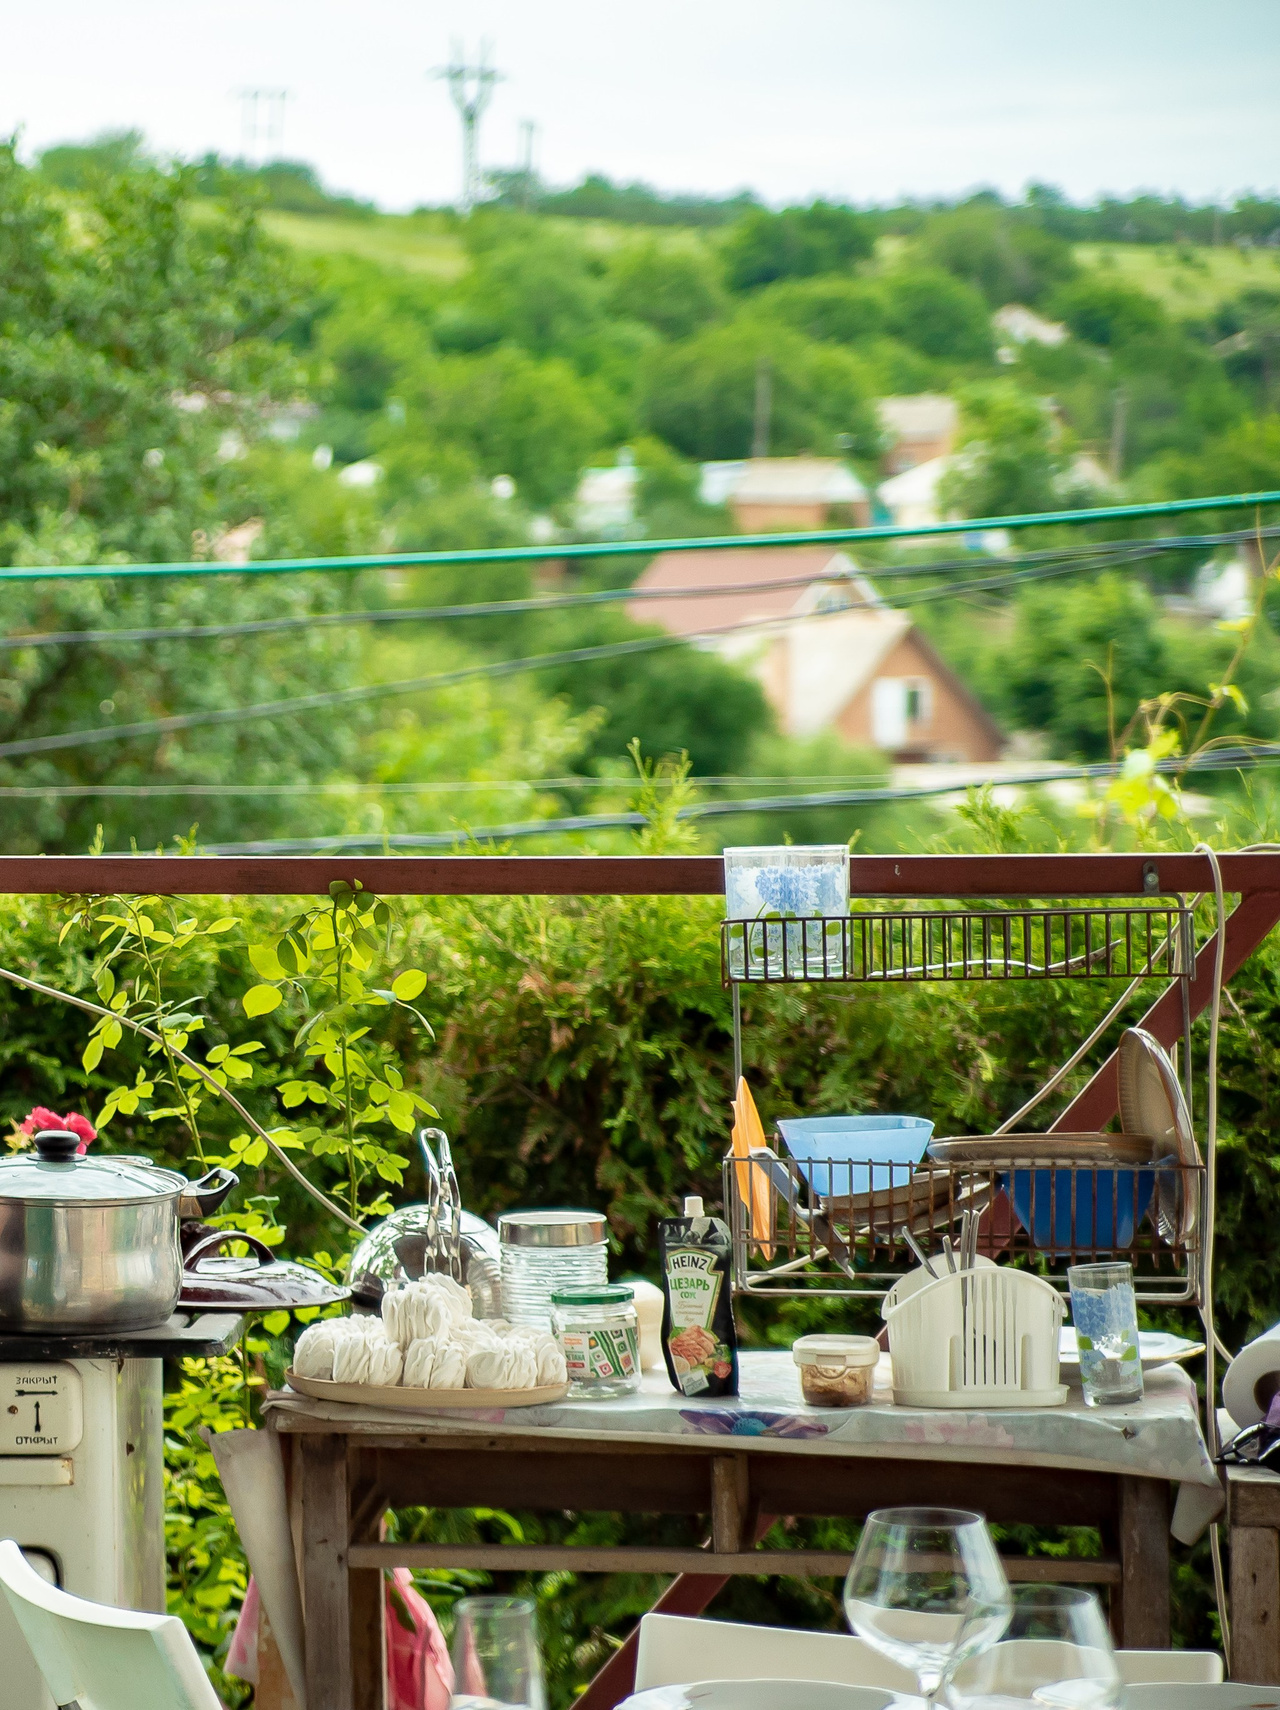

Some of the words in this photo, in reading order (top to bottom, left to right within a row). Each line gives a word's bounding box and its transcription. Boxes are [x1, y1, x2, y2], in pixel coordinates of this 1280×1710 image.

[672, 1256, 708, 1270] HEINZ
[670, 1277, 710, 1291] ЦЕЗАРЬ
[16, 1375, 58, 1385] ЗАКРЫТ
[15, 1436, 58, 1445] ОТКРЫТ
